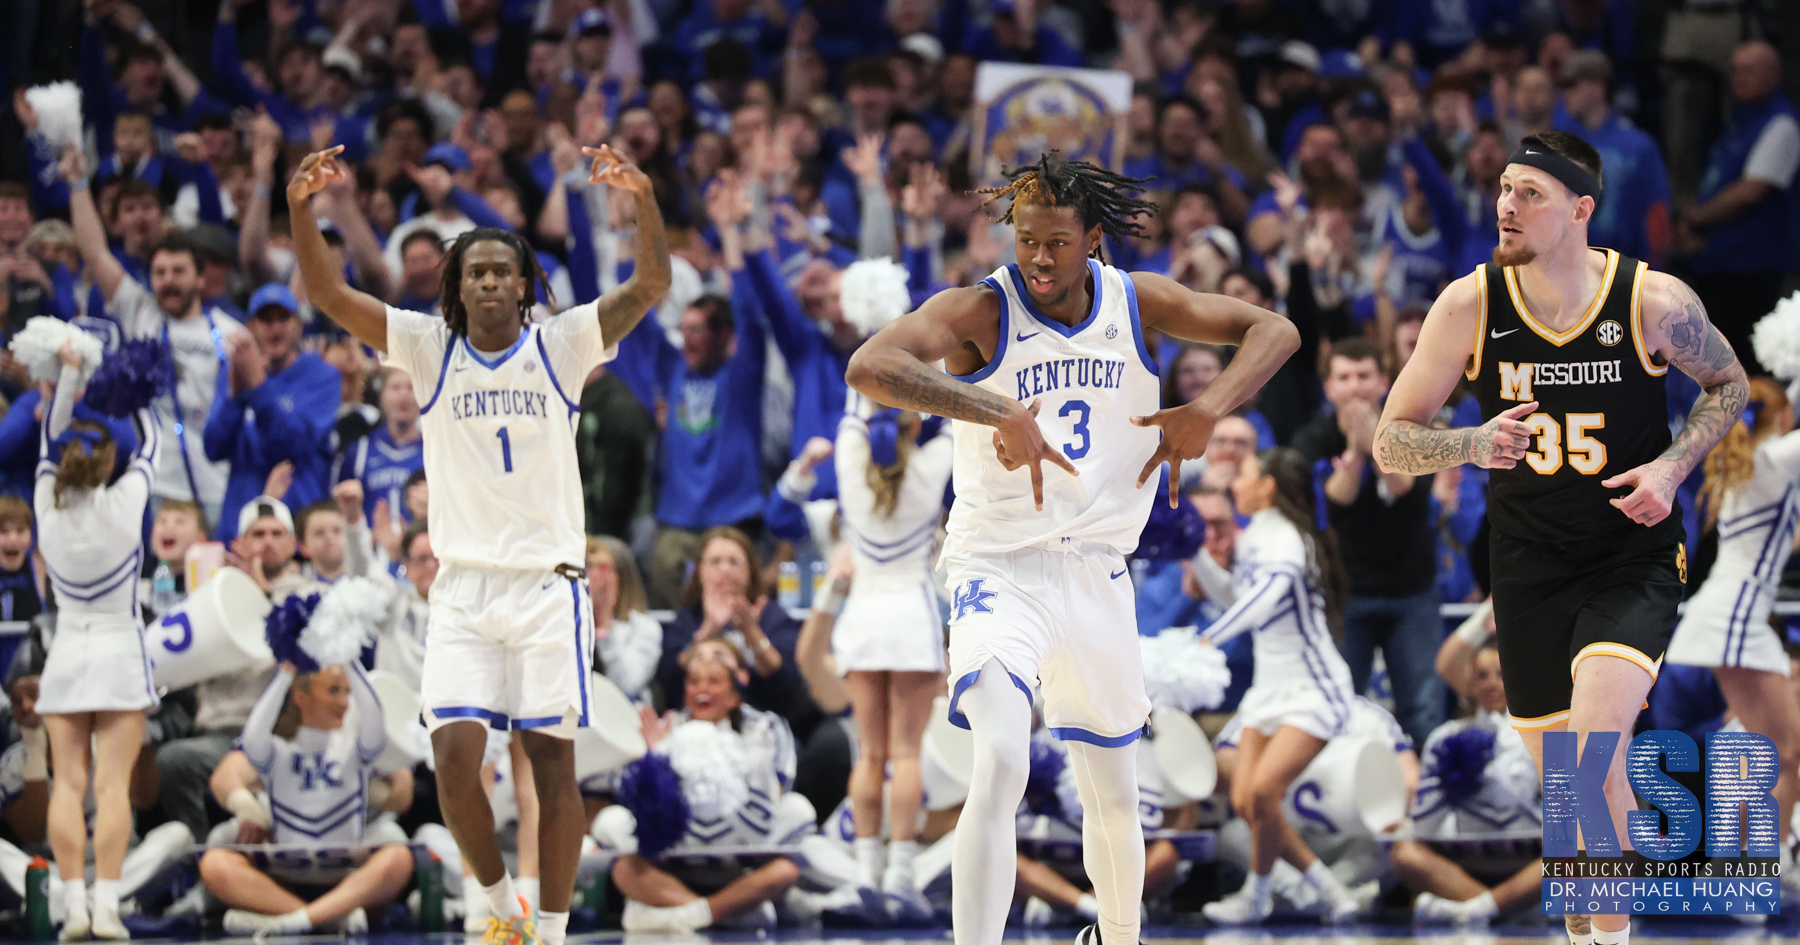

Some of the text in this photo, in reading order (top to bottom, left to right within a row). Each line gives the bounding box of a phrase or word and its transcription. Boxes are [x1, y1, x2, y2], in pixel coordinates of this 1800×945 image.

[1105, 324, 1118, 339] SEC
[1598, 321, 1622, 345] SEC
[1015, 358, 1125, 401] KENTUCKY
[1498, 359, 1622, 402] MISSOURI
[451, 389, 548, 420] KENTUCKY
[496, 426, 513, 473] 1
[1058, 400, 1091, 461] 3
[1523, 412, 1608, 475] 35
[953, 578, 998, 623] UK
[291, 752, 344, 792] UK
